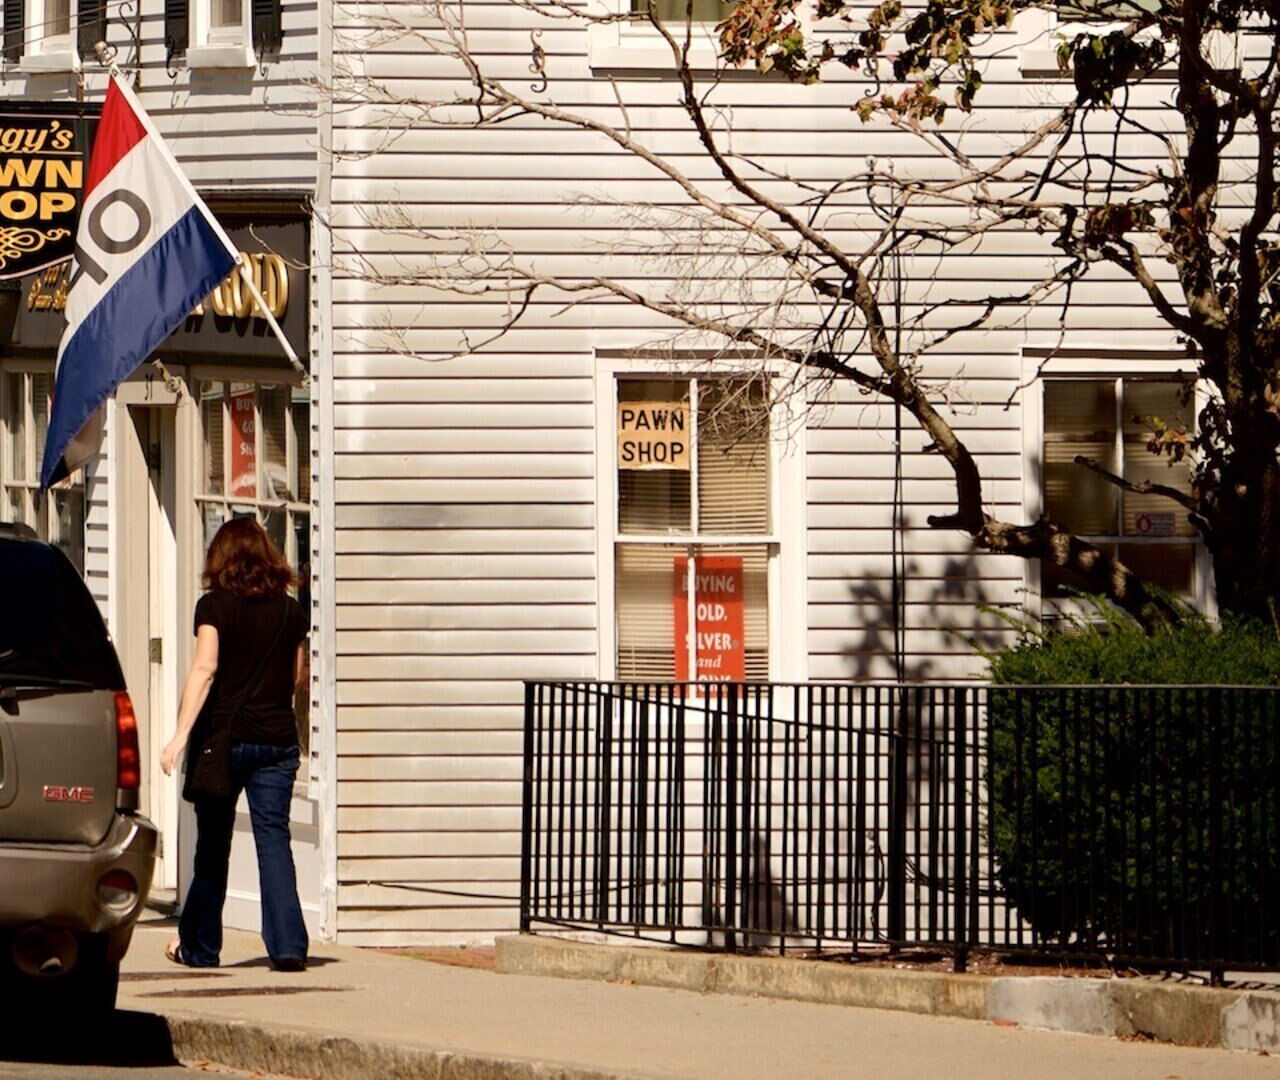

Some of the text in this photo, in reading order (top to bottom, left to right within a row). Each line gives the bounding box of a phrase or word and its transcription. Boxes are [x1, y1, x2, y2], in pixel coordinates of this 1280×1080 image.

[621, 409, 685, 432] PAWN
[622, 441, 685, 463] SHOP
[696, 603, 728, 622] OLD,
[42, 784, 96, 805] GMC
